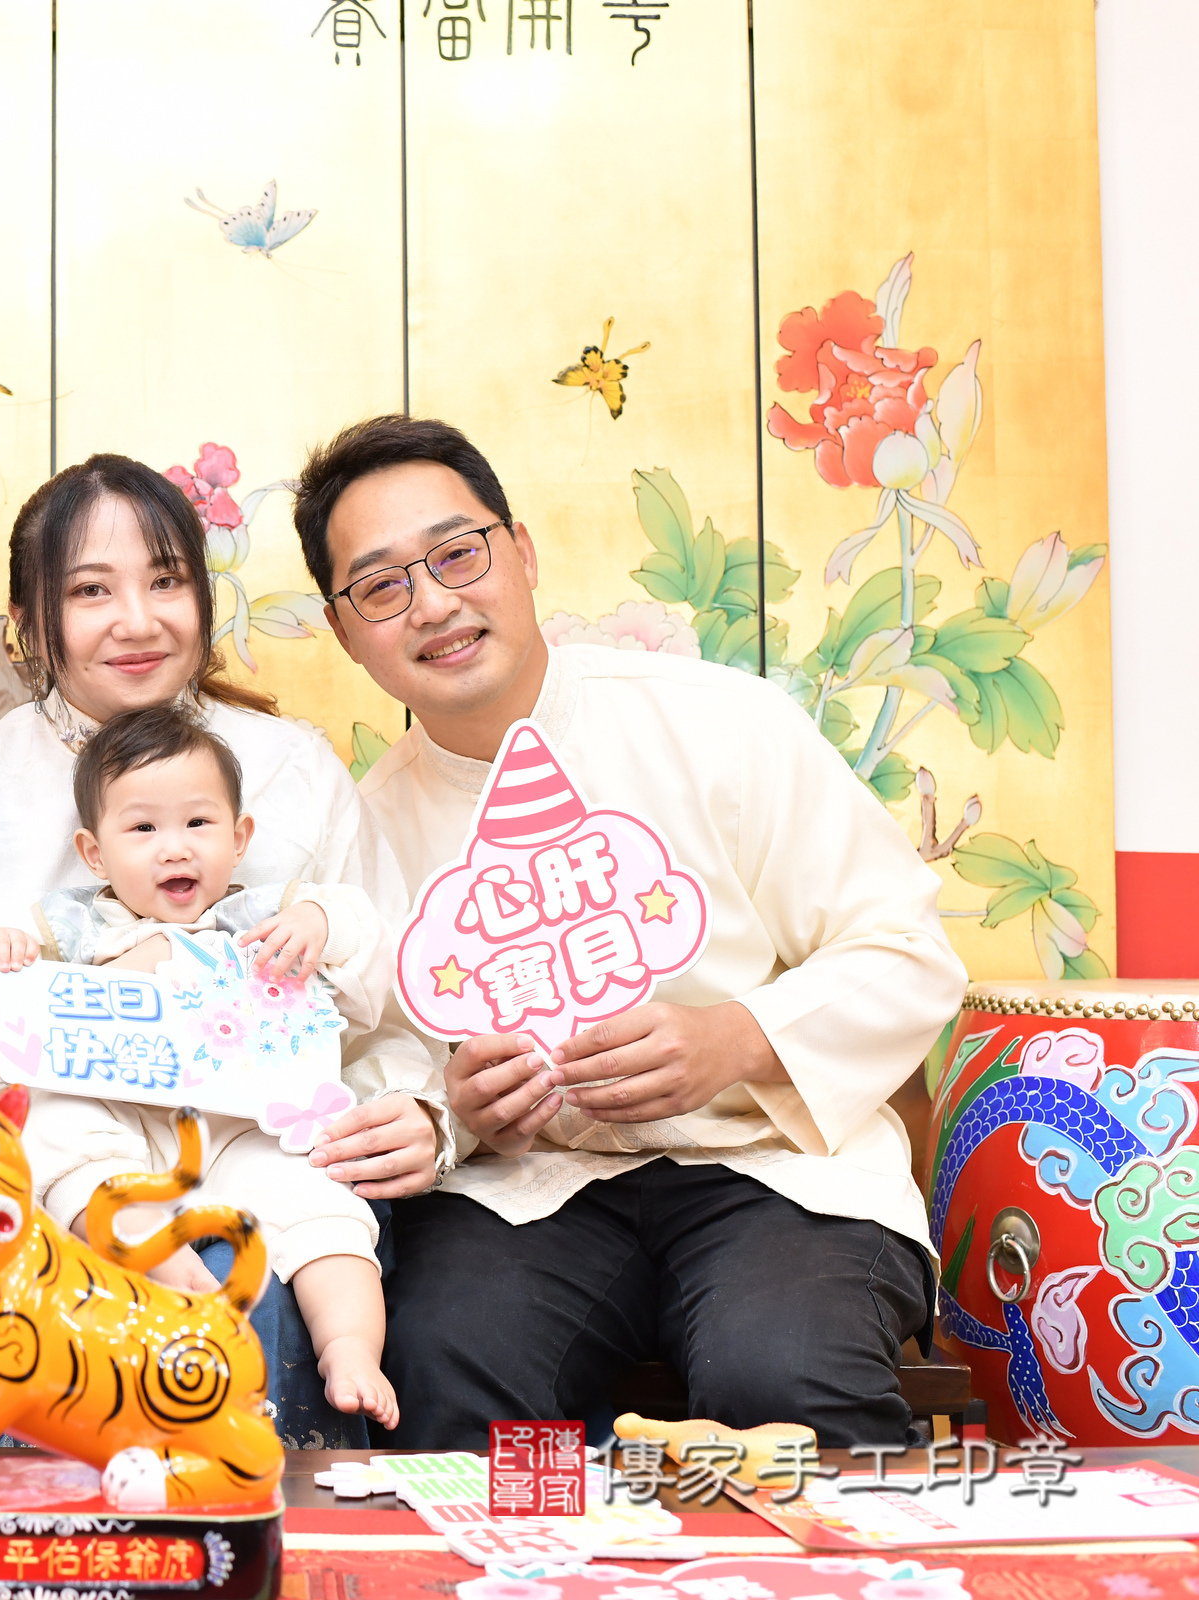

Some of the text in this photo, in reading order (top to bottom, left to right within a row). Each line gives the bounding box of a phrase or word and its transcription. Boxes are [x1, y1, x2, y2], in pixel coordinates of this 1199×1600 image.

[454, 831, 619, 944] 心肝
[48, 971, 163, 1022] 生日
[473, 909, 652, 1033] 寶貝
[43, 1027, 179, 1089] 快樂
